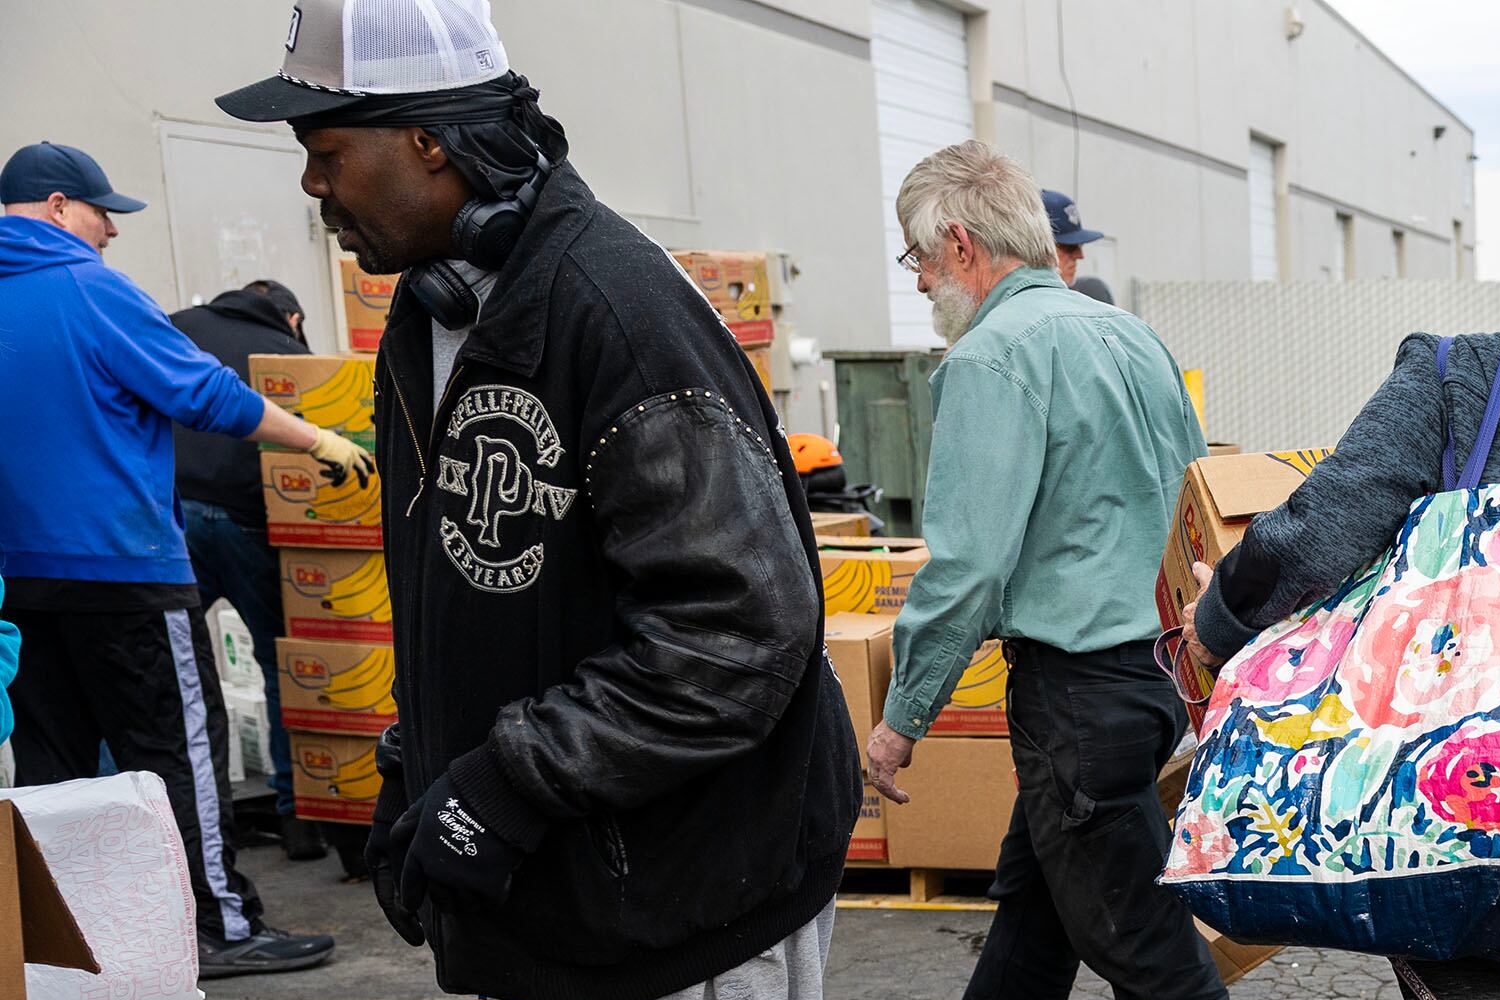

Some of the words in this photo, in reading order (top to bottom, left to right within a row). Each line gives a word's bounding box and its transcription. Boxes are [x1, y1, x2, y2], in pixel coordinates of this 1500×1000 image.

[264, 378, 296, 394] Dole
[281, 471, 312, 490] Dole
[295, 567, 327, 585] Dole
[457, 808, 486, 833] MEMPHIS
